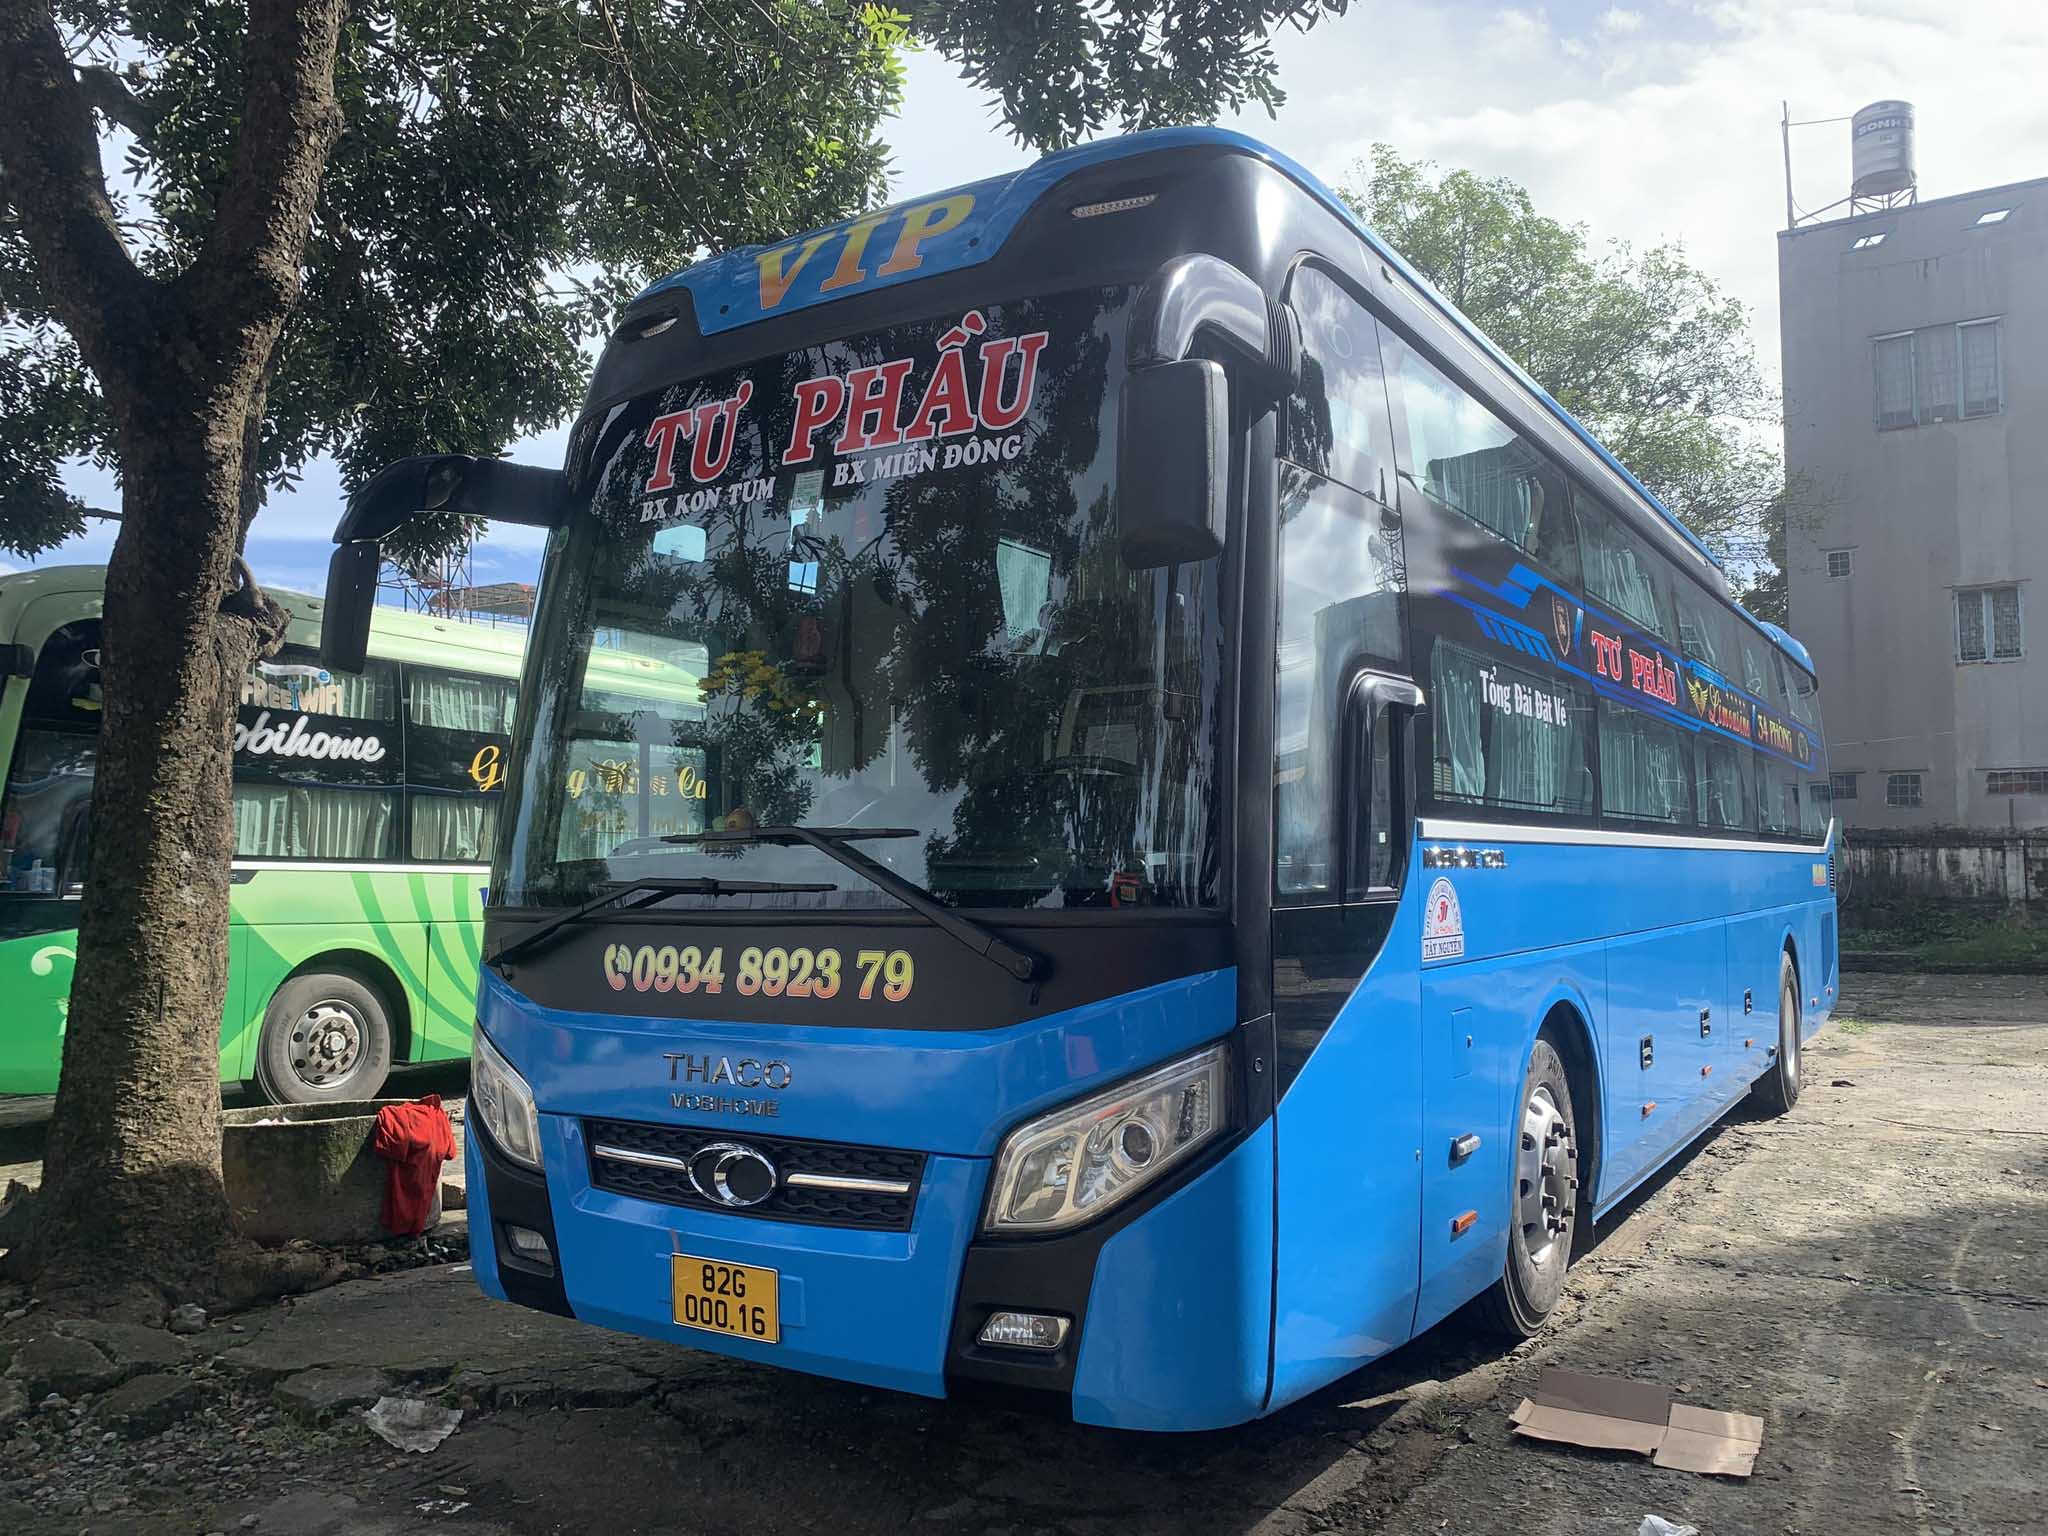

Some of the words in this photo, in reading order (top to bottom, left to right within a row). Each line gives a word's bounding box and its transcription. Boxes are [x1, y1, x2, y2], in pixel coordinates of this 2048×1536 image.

[755, 194, 976, 310] VIP
[645, 380, 753, 493] TƯ
[782, 310, 1049, 465] PHẦU
[833, 460, 867, 487] BX
[871, 441, 939, 481] MIỀN
[942, 434, 1024, 469] ĐÔNG
[640, 499, 667, 523] BX
[674, 487, 723, 516] KON
[729, 477, 776, 506] TUM
[1591, 630, 1622, 681] TƯ
[241, 674, 291, 710] FREE
[299, 684, 344, 716] WIFI
[1480, 666, 1511, 715] Tổng
[1514, 682, 1532, 717] Đài
[1535, 690, 1552, 728] Đặt
[1554, 696, 1566, 727] Vé
[234, 711, 386, 762] obihome
[632, 945, 724, 993] 0934
[736, 947, 842, 998] 8923
[856, 949, 914, 1002] 79
[663, 1052, 793, 1090] THACO
[671, 1093, 780, 1118] MOBIHOME
[702, 1264, 746, 1297] 82G
[685, 1294, 766, 1336] 000.16
